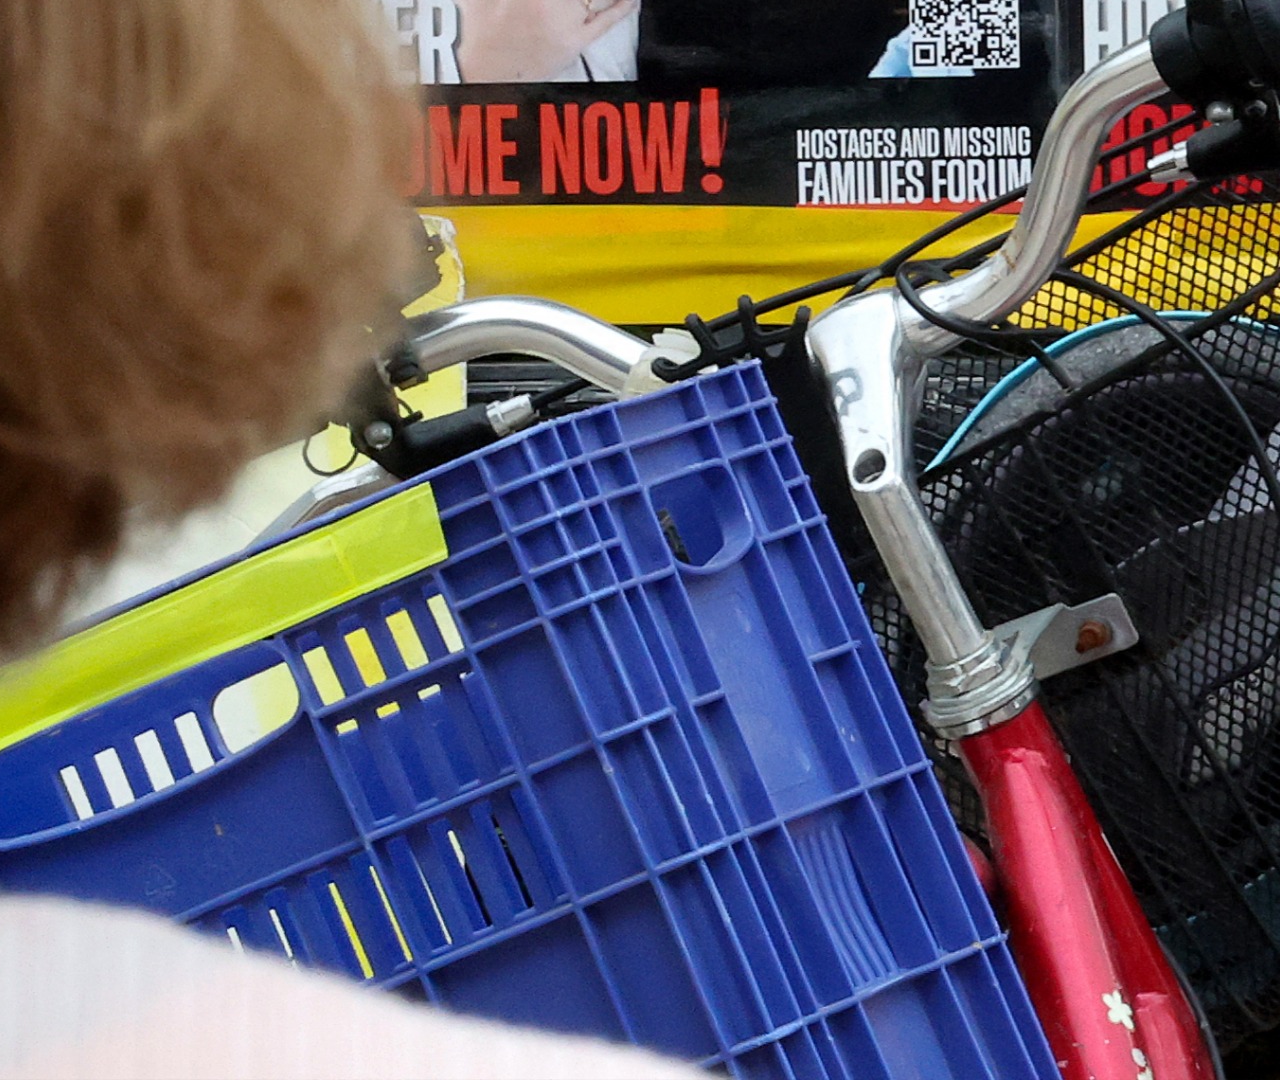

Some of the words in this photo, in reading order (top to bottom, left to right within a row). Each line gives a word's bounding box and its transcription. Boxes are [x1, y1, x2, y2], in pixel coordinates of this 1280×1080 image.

[539, 87, 730, 196] NOW!
[796, 127, 897, 160] HOSTAGES
[900, 126, 940, 159] AND
[943, 125, 1032, 158] MISSING
[797, 158, 926, 206] FAMILIES
[931, 157, 1033, 204] FORUM
